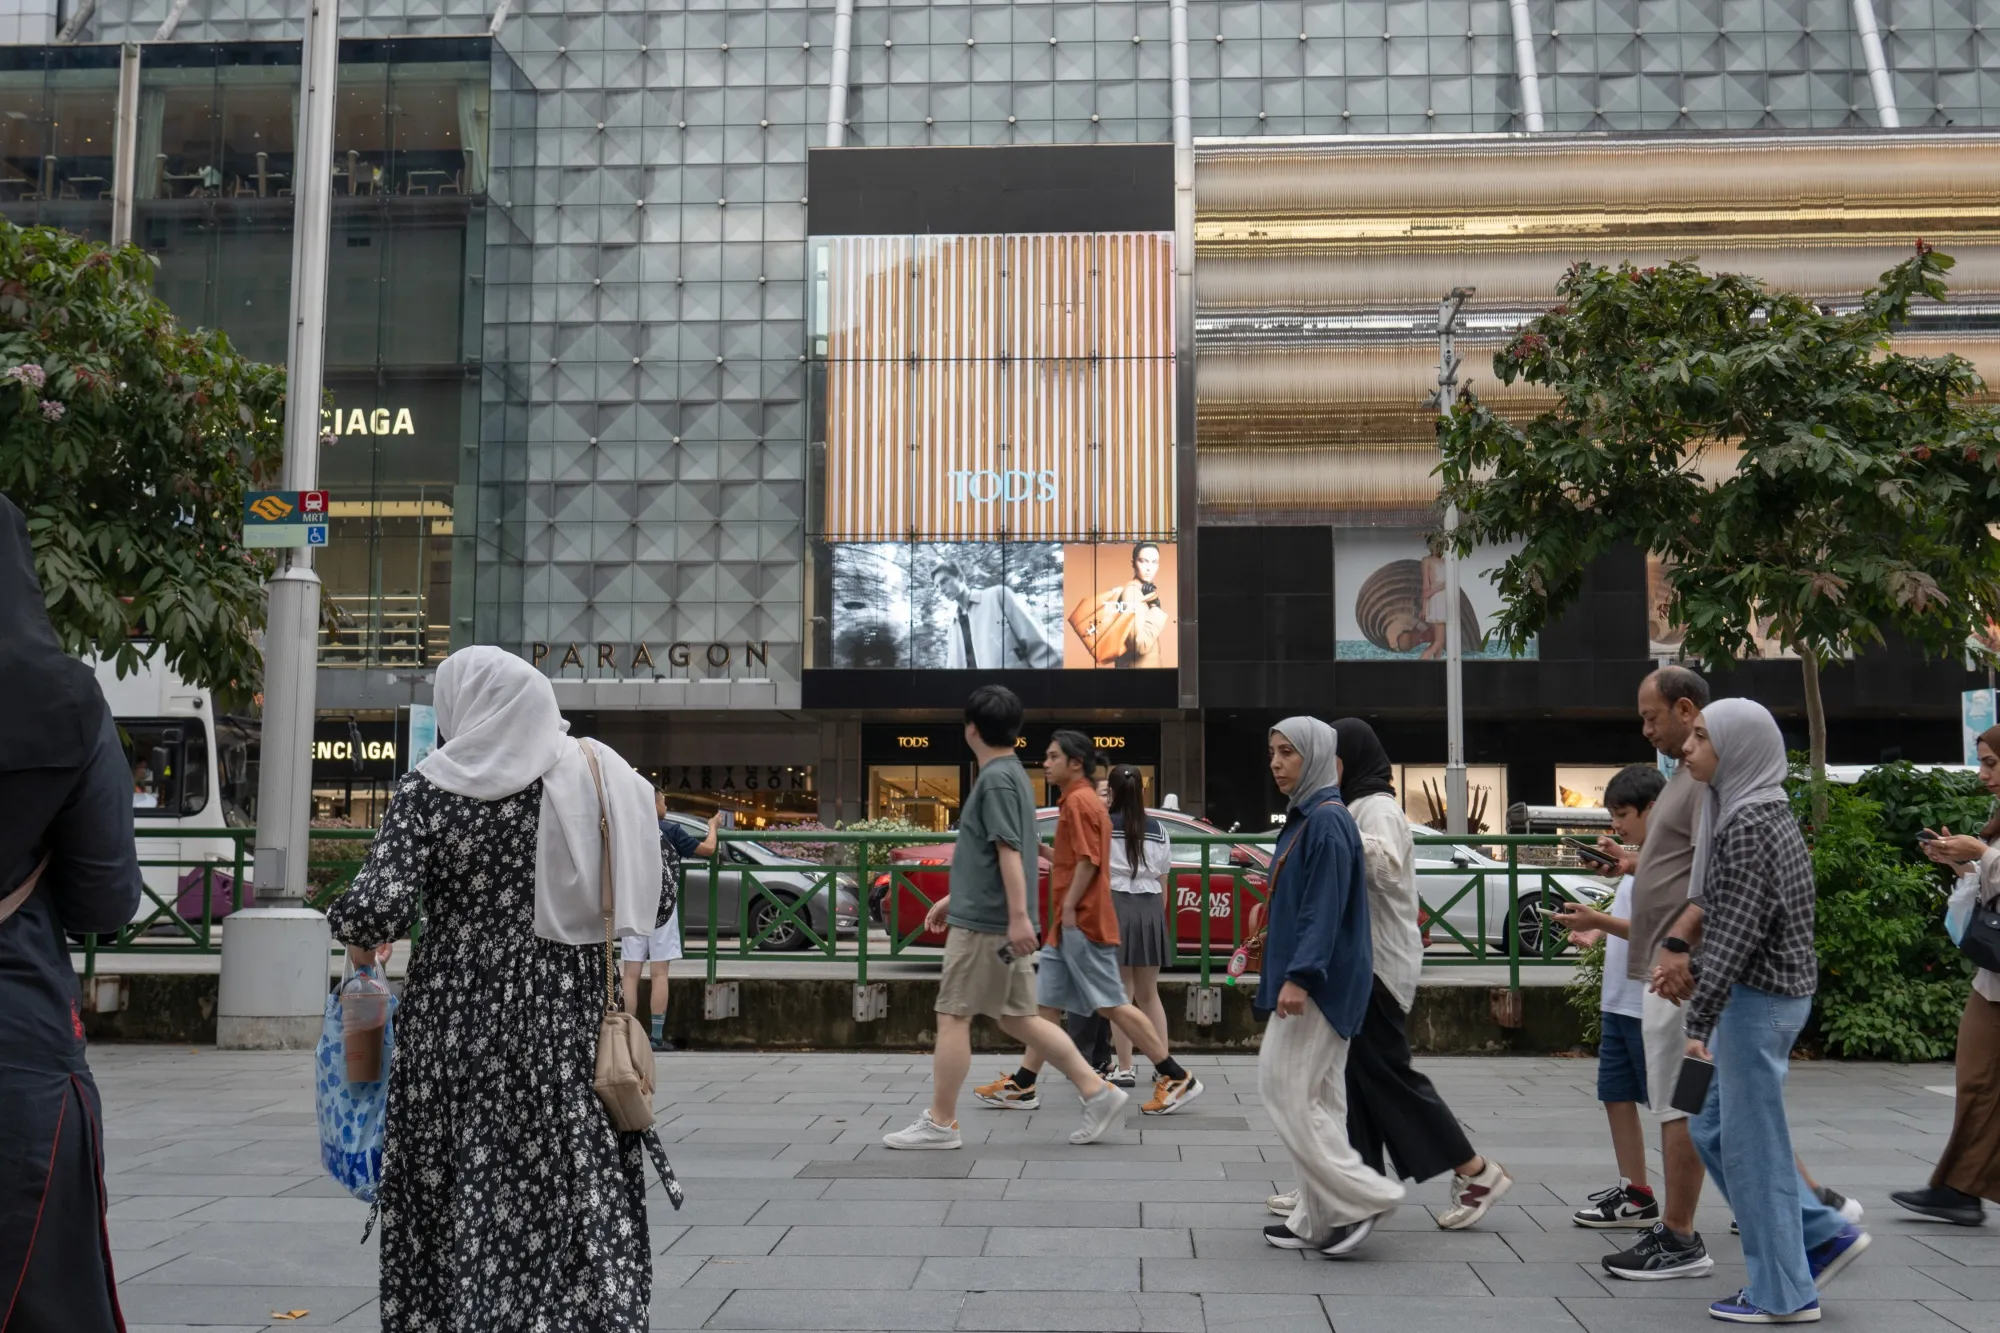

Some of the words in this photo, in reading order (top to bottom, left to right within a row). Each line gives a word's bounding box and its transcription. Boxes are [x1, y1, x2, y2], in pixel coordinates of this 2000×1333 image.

[947, 469, 1056, 502] TOD'S
[302, 512, 325, 523] MRT
[532, 640, 769, 668] PARAGON
[896, 736, 929, 748] TOD'S
[1093, 736, 1126, 748] TOD'S
[660, 775, 805, 790] PARAGON
[1270, 814, 1287, 824] PR
